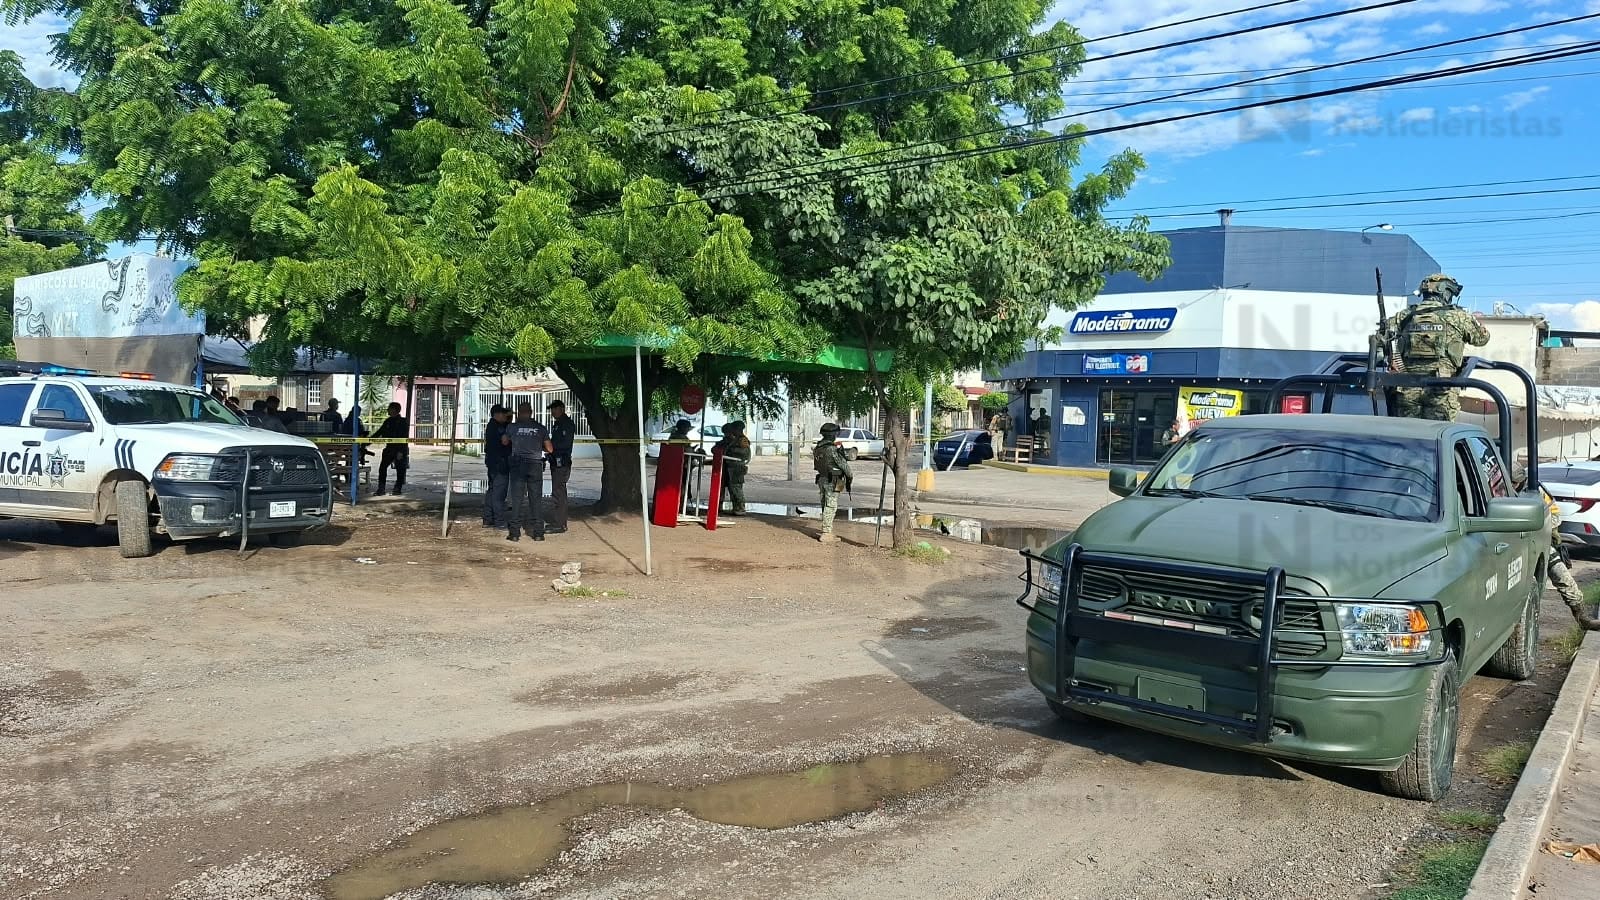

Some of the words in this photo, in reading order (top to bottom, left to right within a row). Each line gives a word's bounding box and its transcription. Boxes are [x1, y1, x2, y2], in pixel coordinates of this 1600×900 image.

[1073, 313, 1171, 332] Modelorama
[1195, 408, 1225, 419] NUEVA
[0, 447, 43, 476] ICÍA
[1134, 590, 1232, 617] RAM
